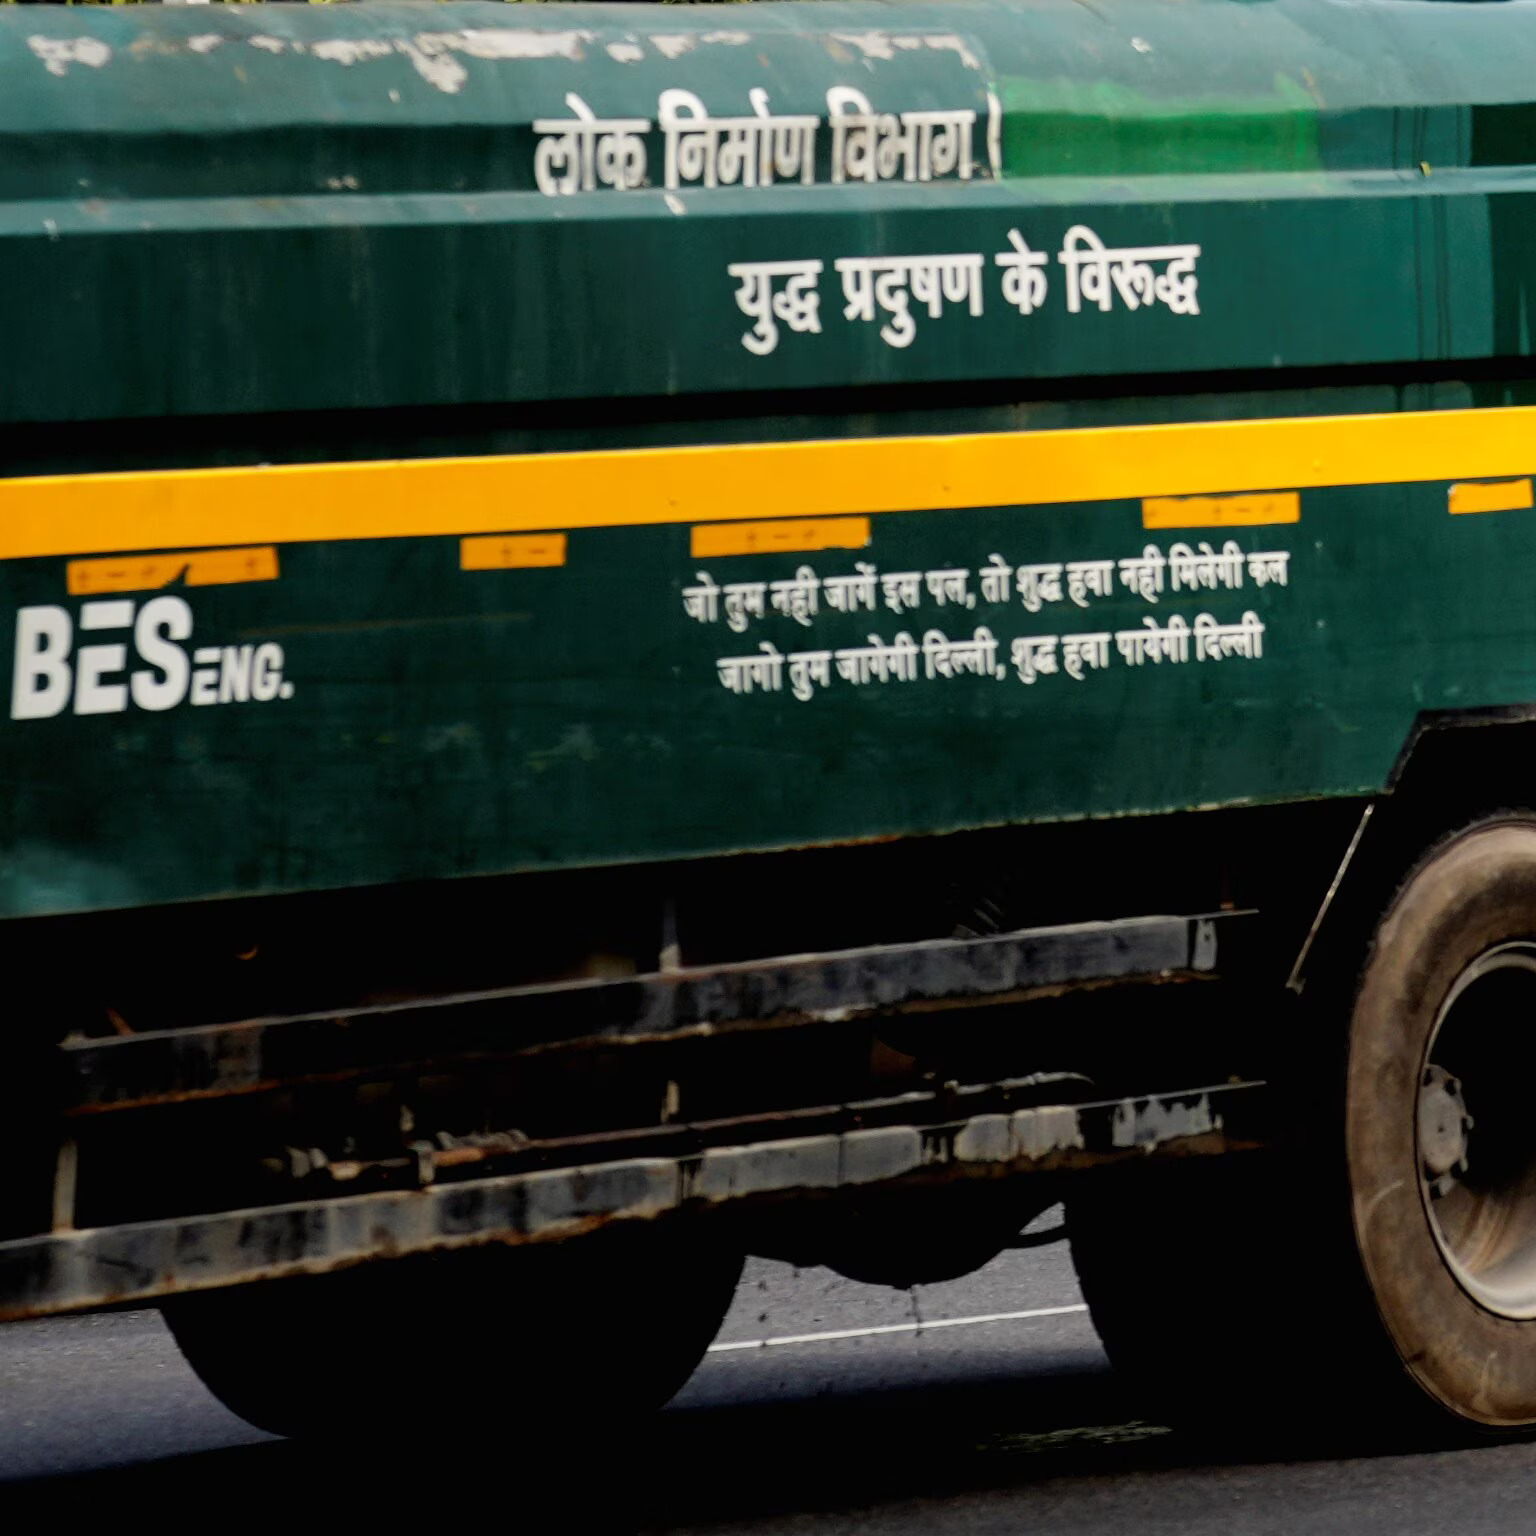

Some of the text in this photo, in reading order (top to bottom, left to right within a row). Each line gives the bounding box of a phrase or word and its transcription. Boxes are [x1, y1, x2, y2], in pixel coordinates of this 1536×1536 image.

[532, 85, 977, 197] लोक निर्माण विभाग
[728, 224, 1201, 355] युद्ध प्रदुषण के विरूद्ध
[682, 571, 721, 622] जो
[722, 582, 768, 633] तुम
[880, 571, 924, 615] इस
[979, 553, 1013, 603] तो
[1016, 563, 1064, 613] शुद्ध
[1065, 559, 1116, 608] हवा
[1168, 539, 1246, 592] मिलेगी
[1247, 550, 1291, 588] कल
[716, 640, 785, 694] जागो
[786, 650, 833, 702] तुम
[834, 631, 920, 685] जागेगी
[1011, 635, 1059, 685] शुद्ध
[1060, 632, 1112, 681] हवा
[1115, 613, 1191, 667] पायेगी
[1193, 610, 1266, 663] दिल्ली
